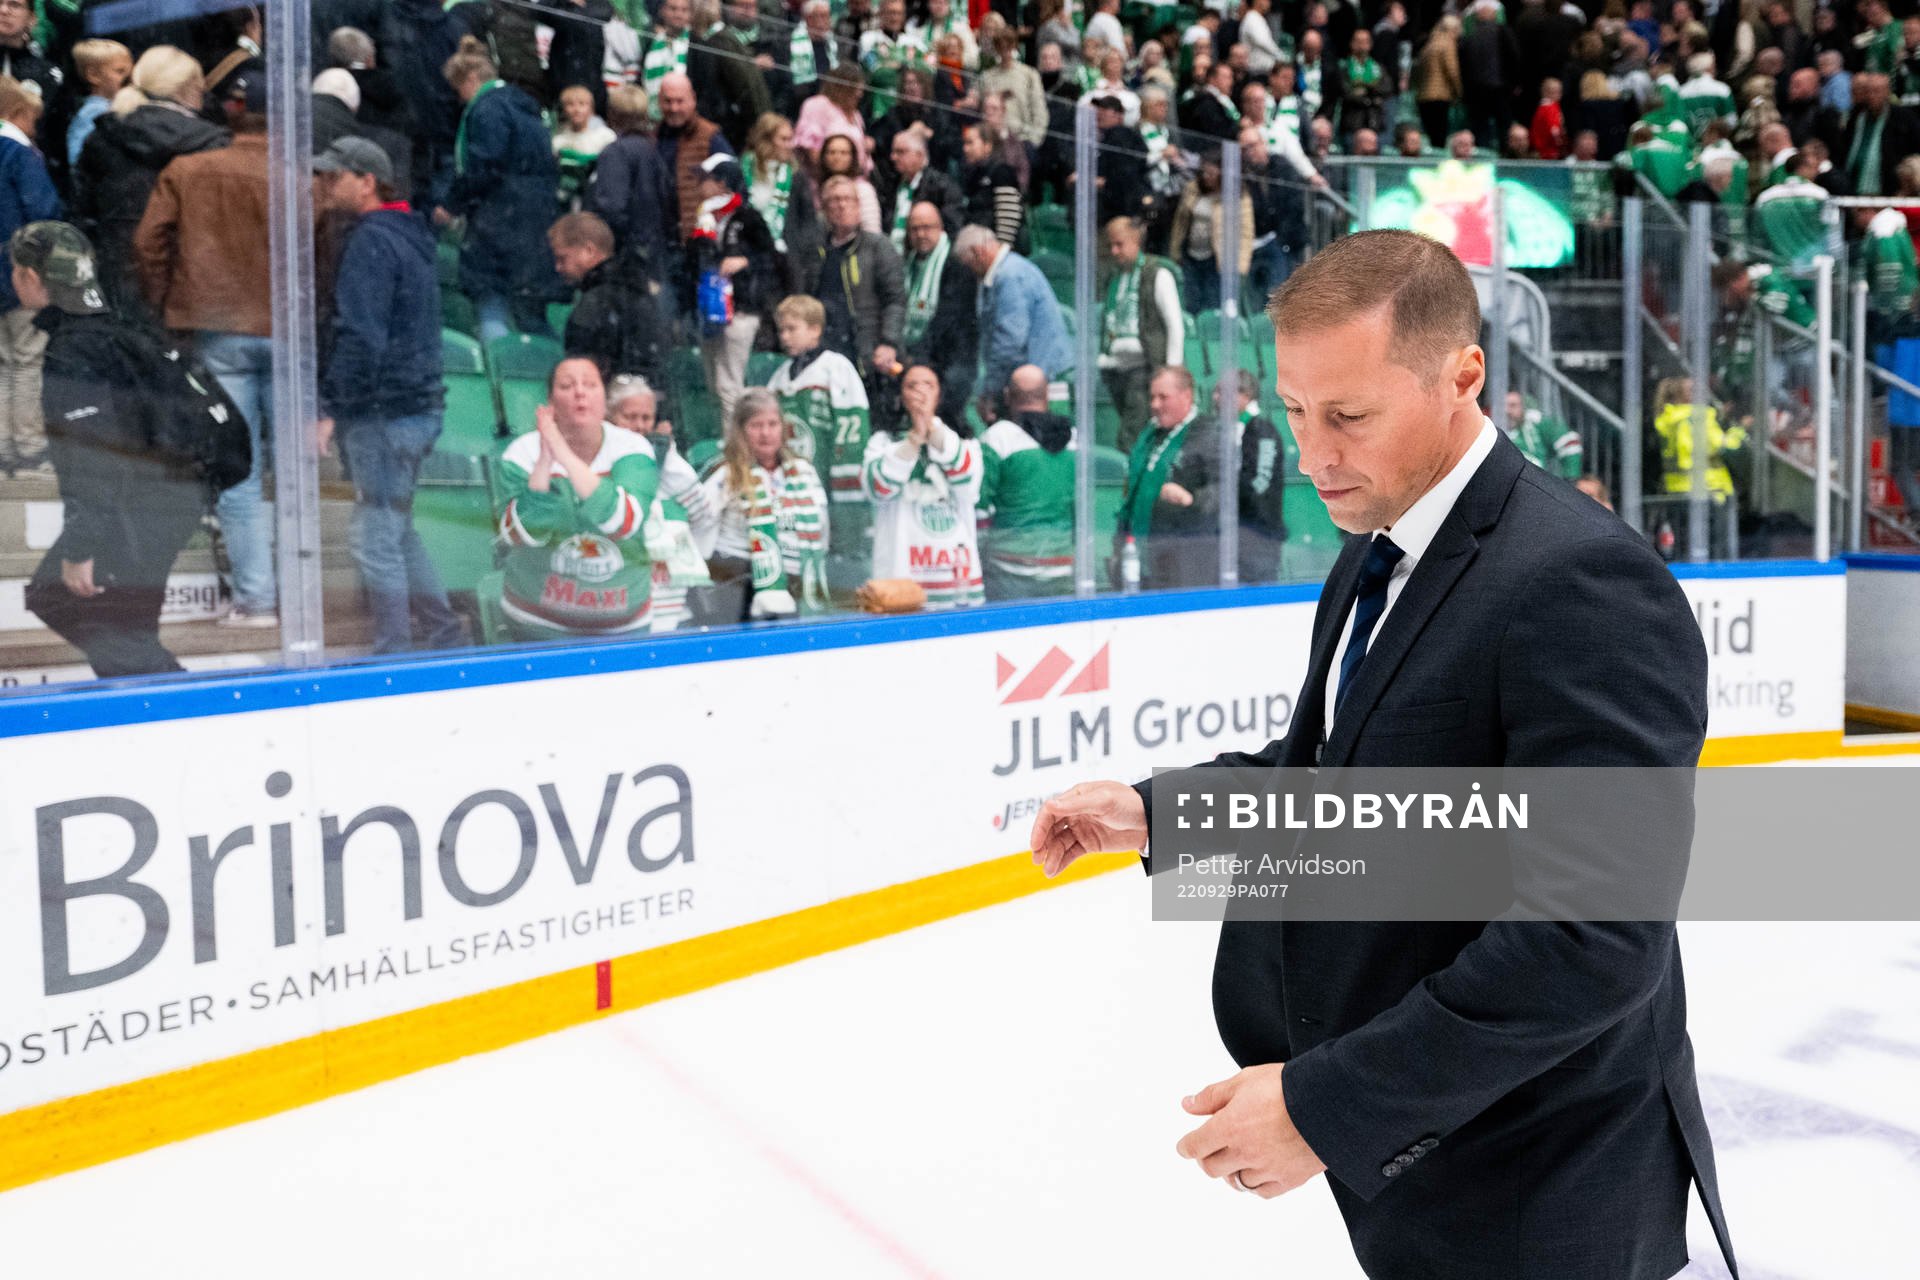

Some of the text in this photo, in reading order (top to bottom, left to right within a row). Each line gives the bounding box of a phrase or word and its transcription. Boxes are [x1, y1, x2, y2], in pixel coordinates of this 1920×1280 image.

[835, 415, 861, 445] 72
[992, 693, 1292, 777] JLM Group
[1708, 672, 1795, 718] kring
[35, 763, 695, 997] Brinova
[250, 888, 694, 1011] SAMHÄLLSFASTIGHETER
